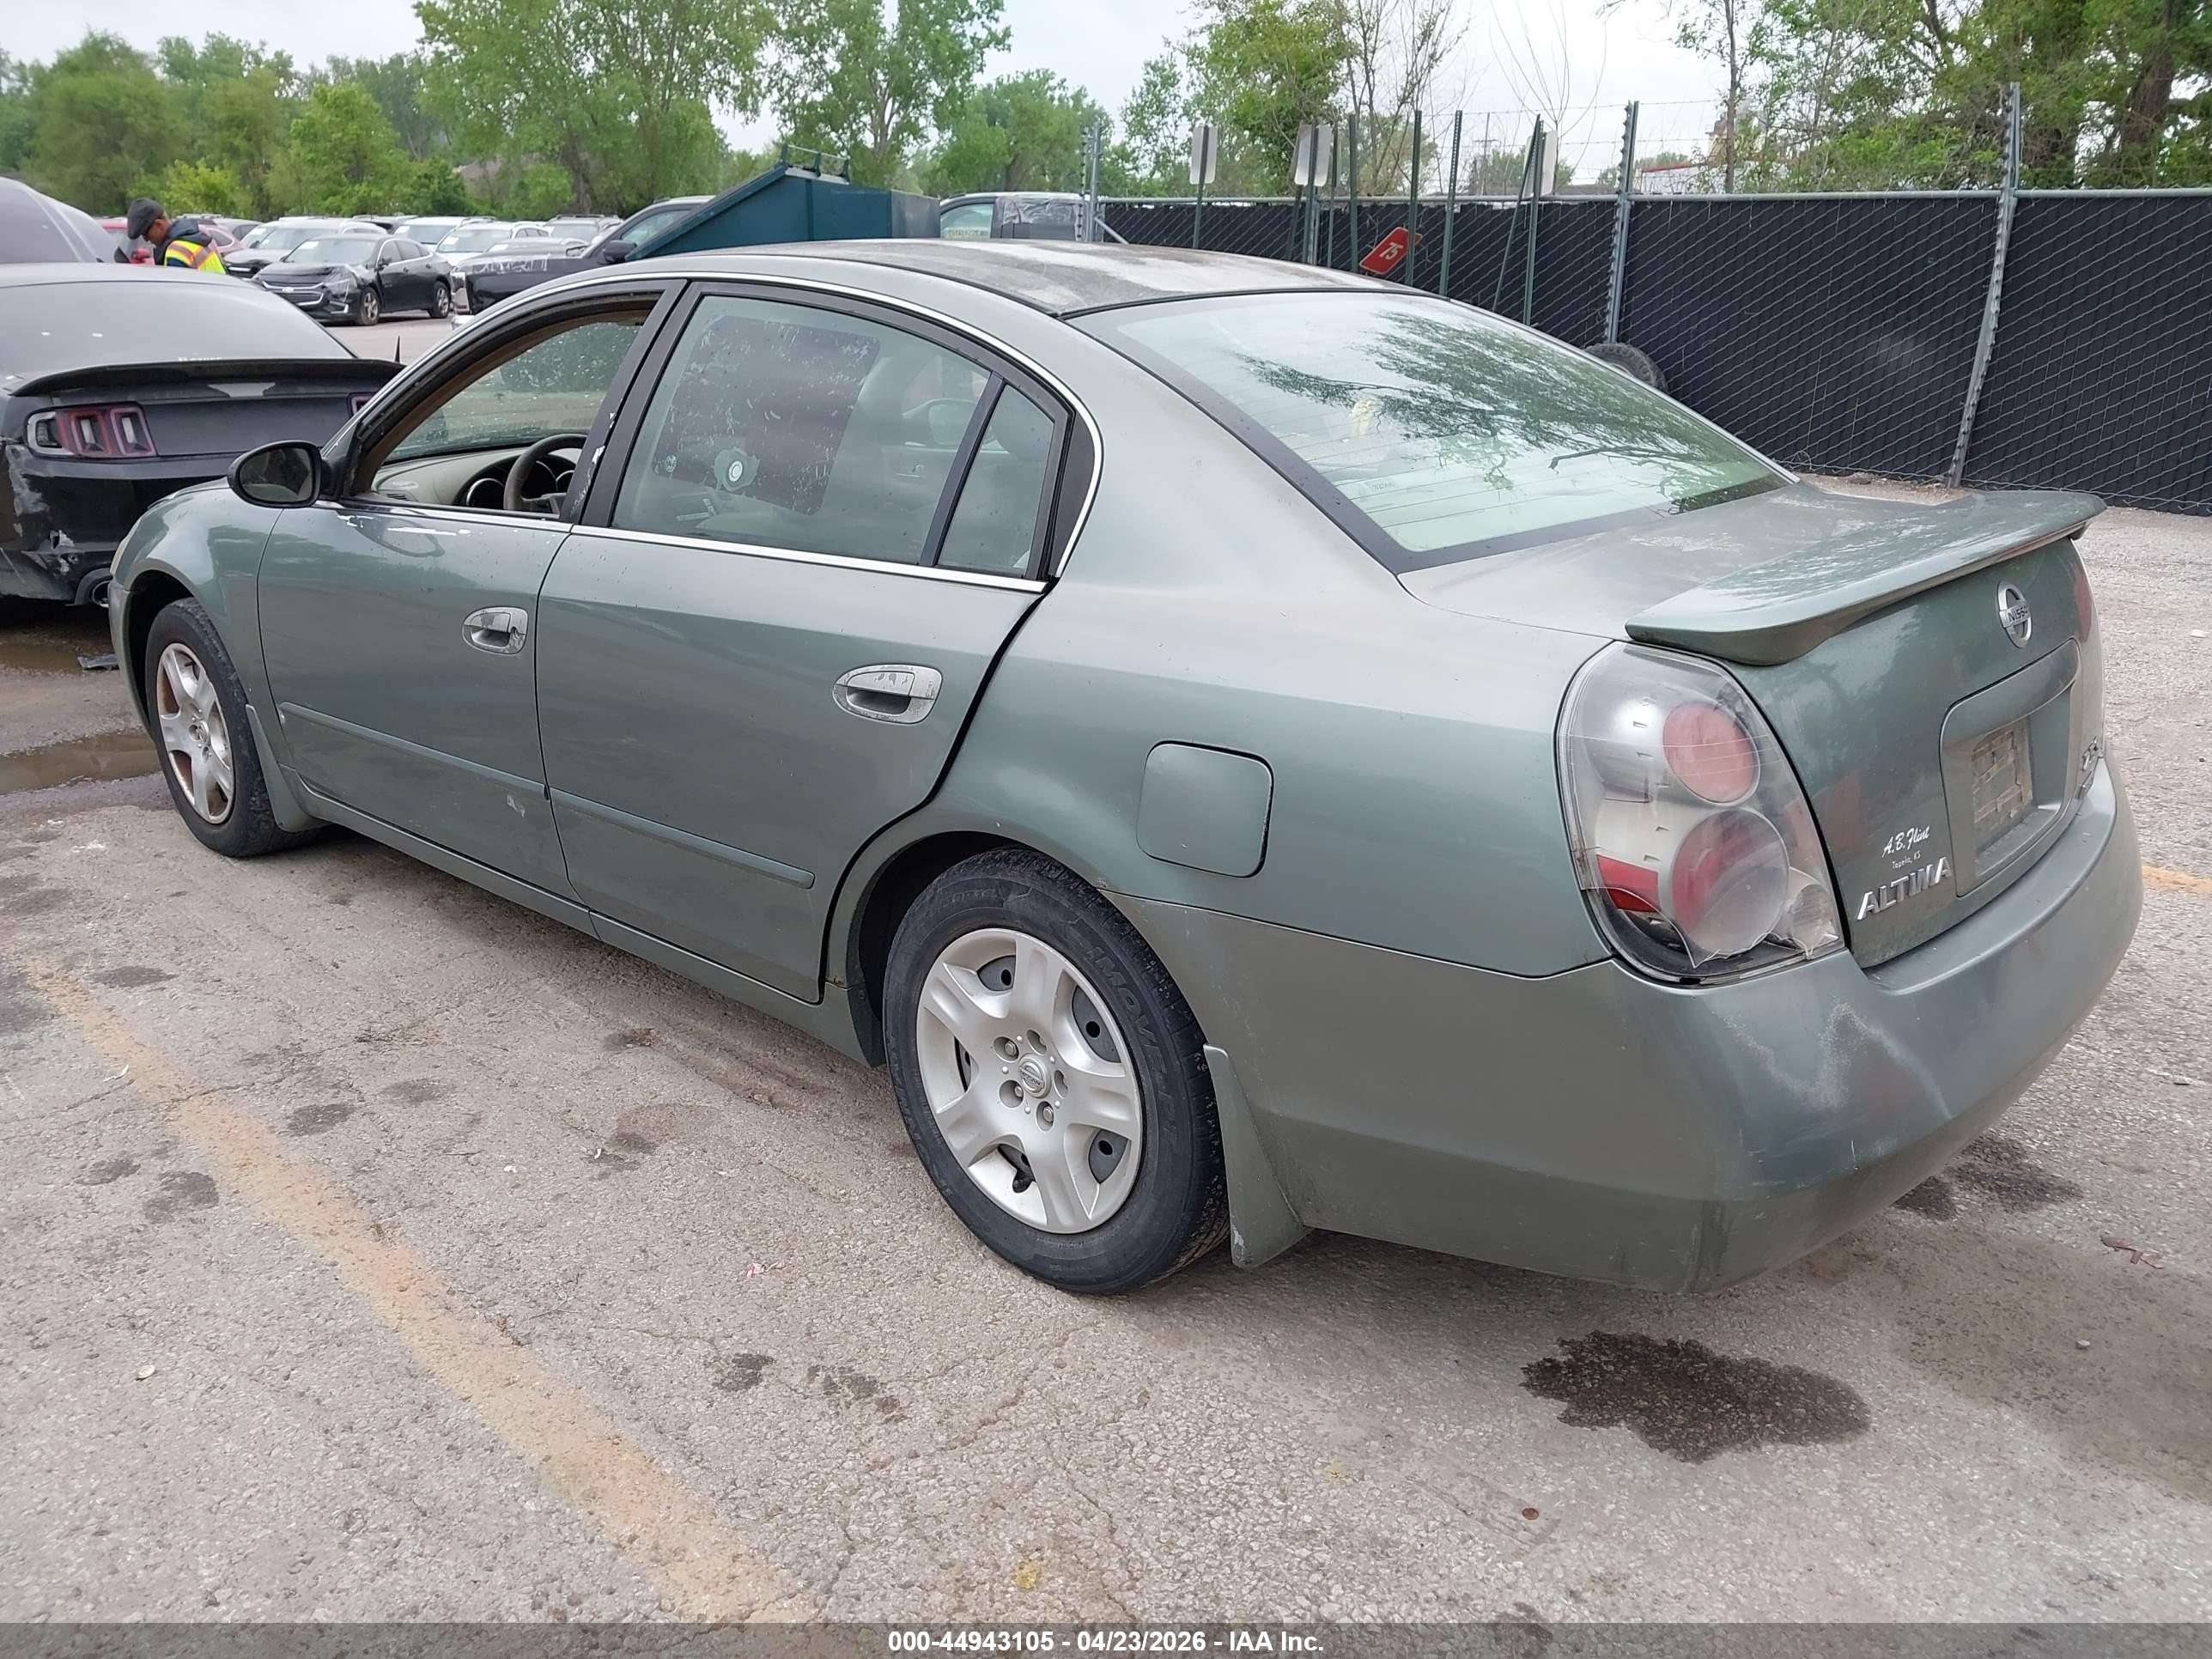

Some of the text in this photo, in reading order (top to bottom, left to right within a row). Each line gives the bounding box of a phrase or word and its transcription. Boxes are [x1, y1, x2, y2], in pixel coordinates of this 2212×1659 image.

[1379, 241, 1404, 260] 75
[1906, 825, 1930, 850] Flint
[1856, 857, 1952, 921] ALTIMA
